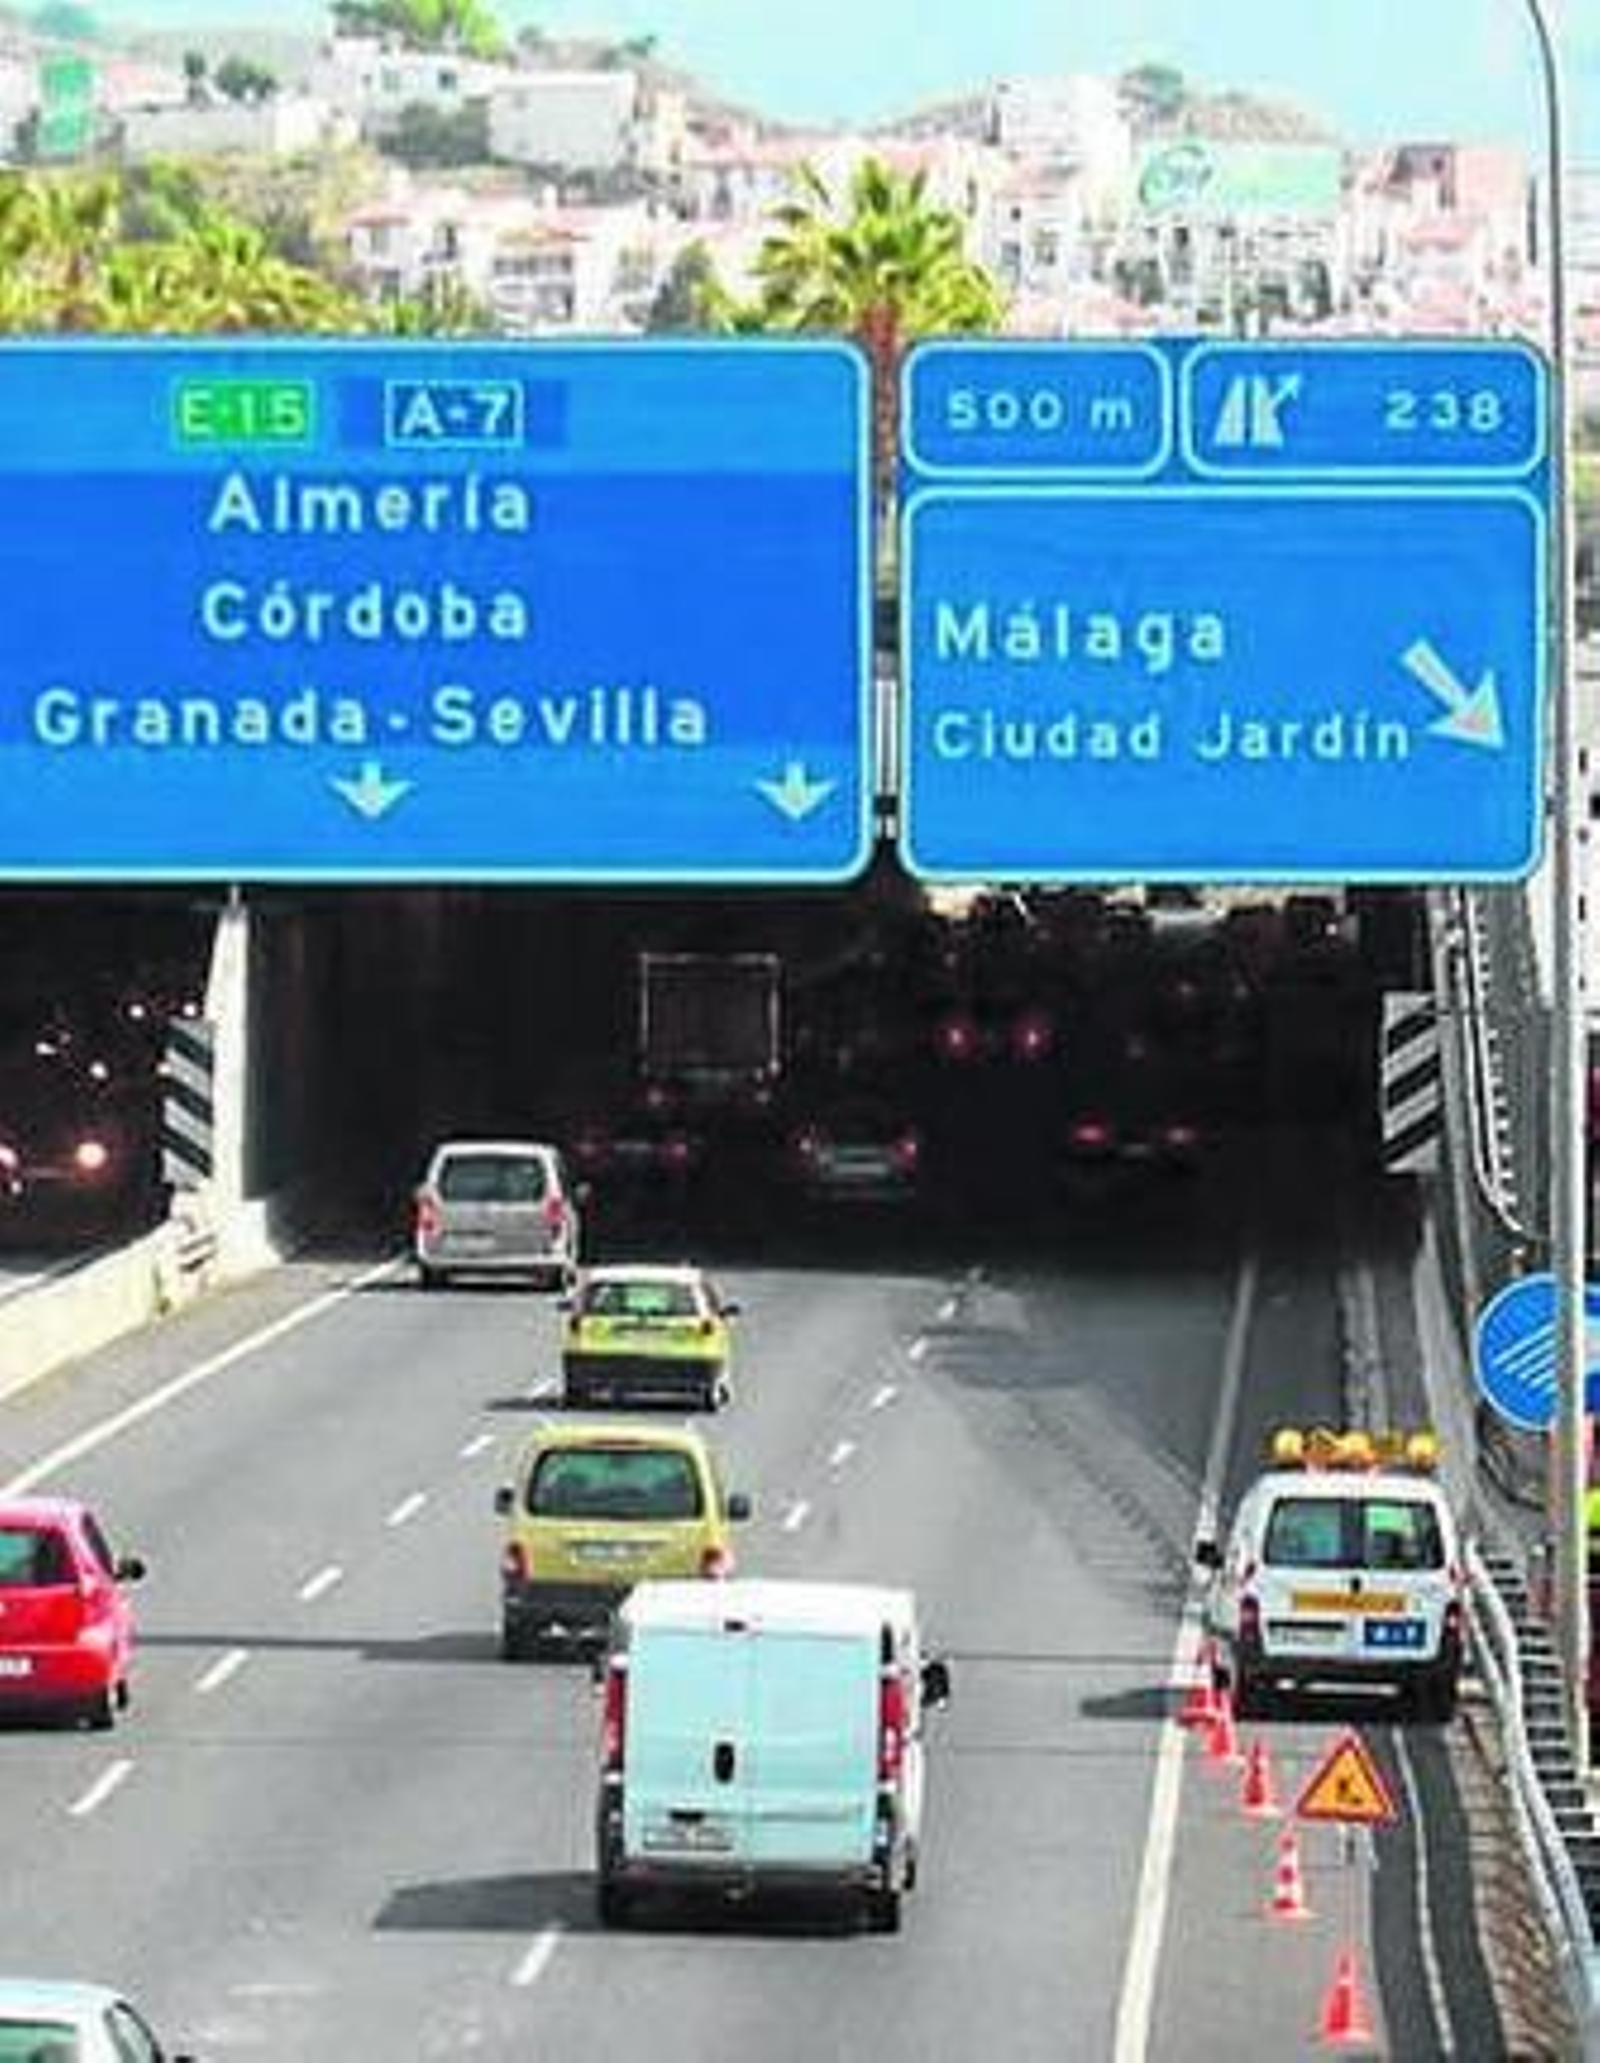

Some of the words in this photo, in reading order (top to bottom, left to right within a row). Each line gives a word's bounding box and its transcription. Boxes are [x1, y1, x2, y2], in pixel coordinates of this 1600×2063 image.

[401, 389, 510, 435] A-7
[946, 390, 1063, 430] 500
[1090, 397, 1133, 430] m
[1384, 390, 1503, 431] 238
[208, 471, 529, 532] Almería
[202, 579, 528, 640] Córdoba
[935, 600, 1225, 674] Málaga
[933, 710, 1161, 759] Ciudad
[1195, 710, 1409, 760] Jardín
